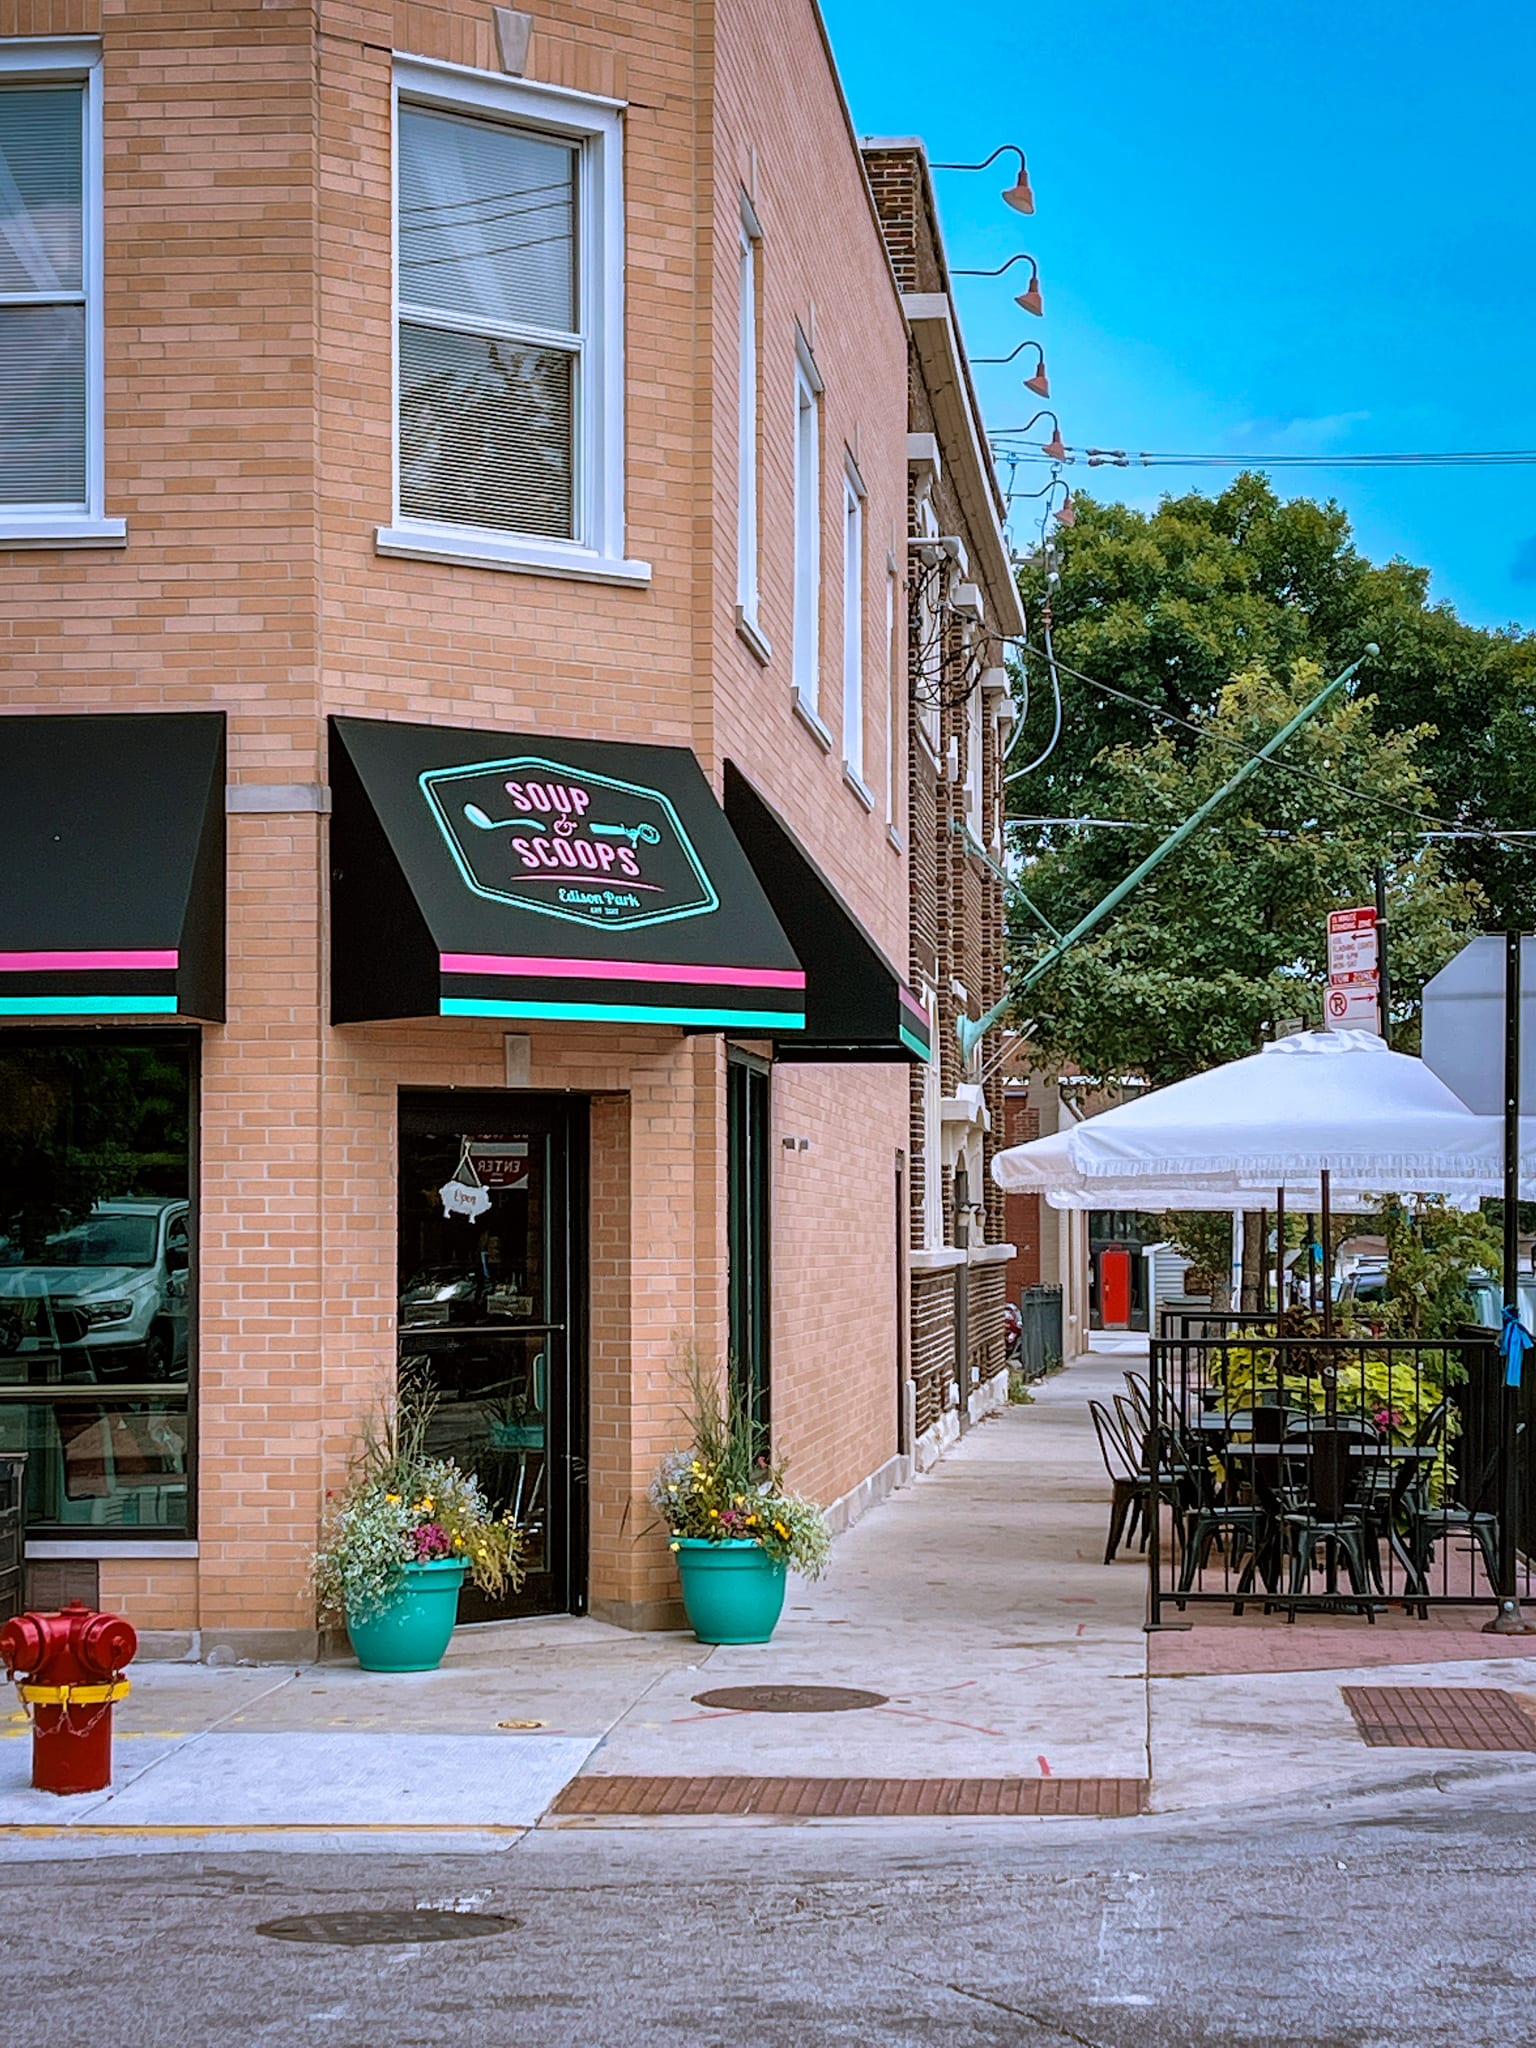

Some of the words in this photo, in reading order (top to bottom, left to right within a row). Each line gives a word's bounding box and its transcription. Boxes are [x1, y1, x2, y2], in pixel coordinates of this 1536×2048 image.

[505, 781, 590, 816] SOUP
[553, 813, 578, 837] &
[511, 837, 640, 876] SCOOPS
[558, 887, 605, 905] Edison
[603, 890, 640, 907] Park
